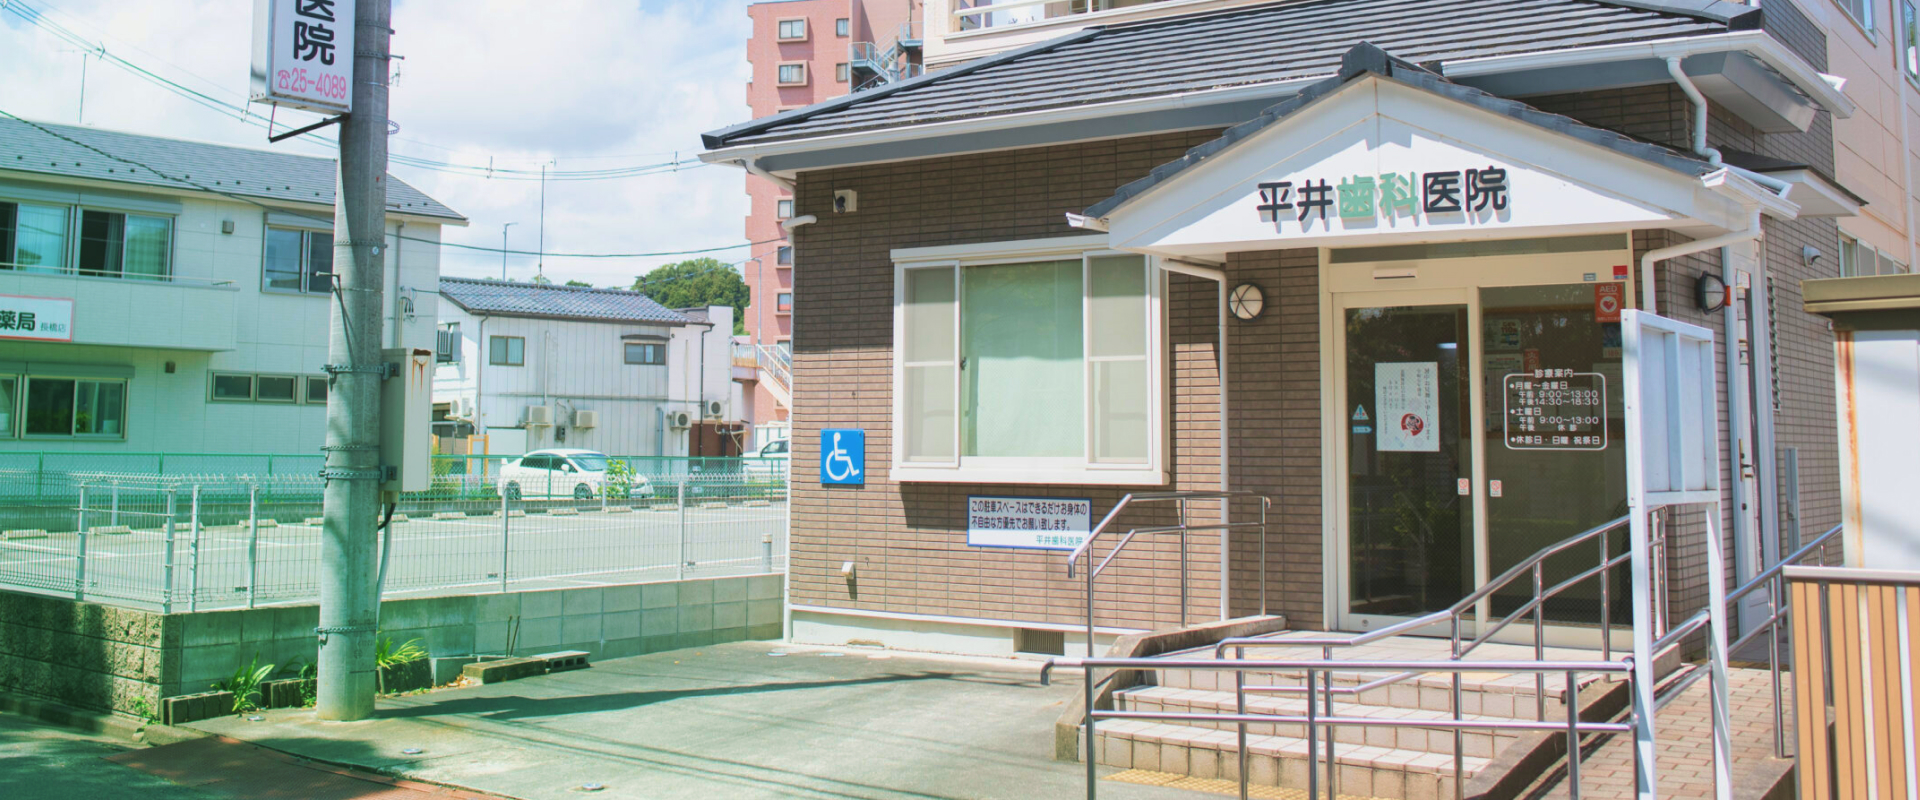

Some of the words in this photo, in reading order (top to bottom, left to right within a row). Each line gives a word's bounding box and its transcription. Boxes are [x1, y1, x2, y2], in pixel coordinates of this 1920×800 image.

[291, 67, 347, 99] 25-4089
[1256, 165, 1507, 222] 平井歯科医院
[1600, 285, 1617, 293] AED
[0, 310, 36, 331] 薬局
[1534, 368, 1573, 378] 診療案内
[1515, 407, 1542, 416] 土曜日
[971, 500, 1087, 515] この駐車スペースはできるだけお身体の
[971, 515, 1070, 531] 不自由な方優先でお願い致します。
[1036, 535, 1083, 546] 平井歯科医院
